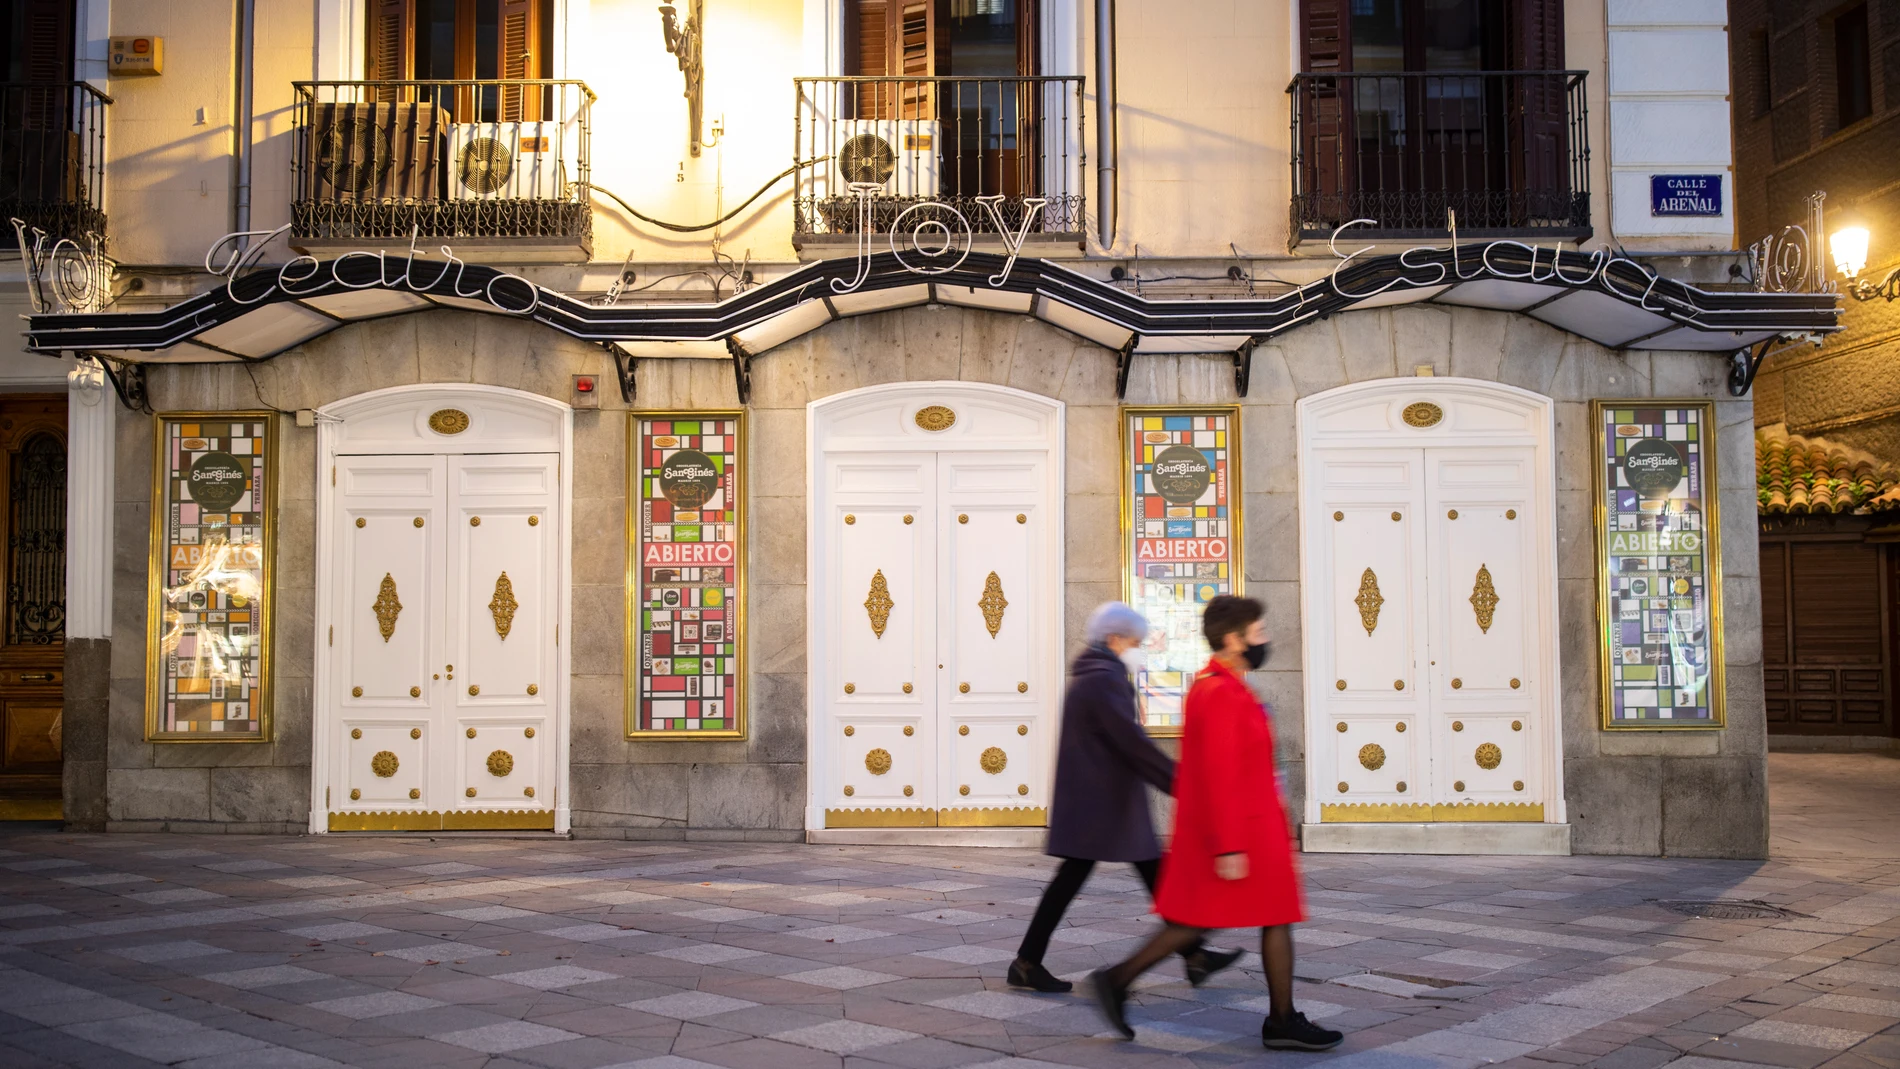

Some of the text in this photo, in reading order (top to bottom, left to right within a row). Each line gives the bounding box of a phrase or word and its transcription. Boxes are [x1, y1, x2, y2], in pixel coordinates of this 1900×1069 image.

[1667, 179, 1707, 189] CALLE
[1659, 198, 1716, 211] ARENAL
[205, 223, 538, 314] Teatro
[1328, 206, 1664, 311] Eslava
[172, 547, 257, 565] ABETO
[645, 544, 732, 562] ABIERTO
[1139, 539, 1226, 558] ABIERTO
